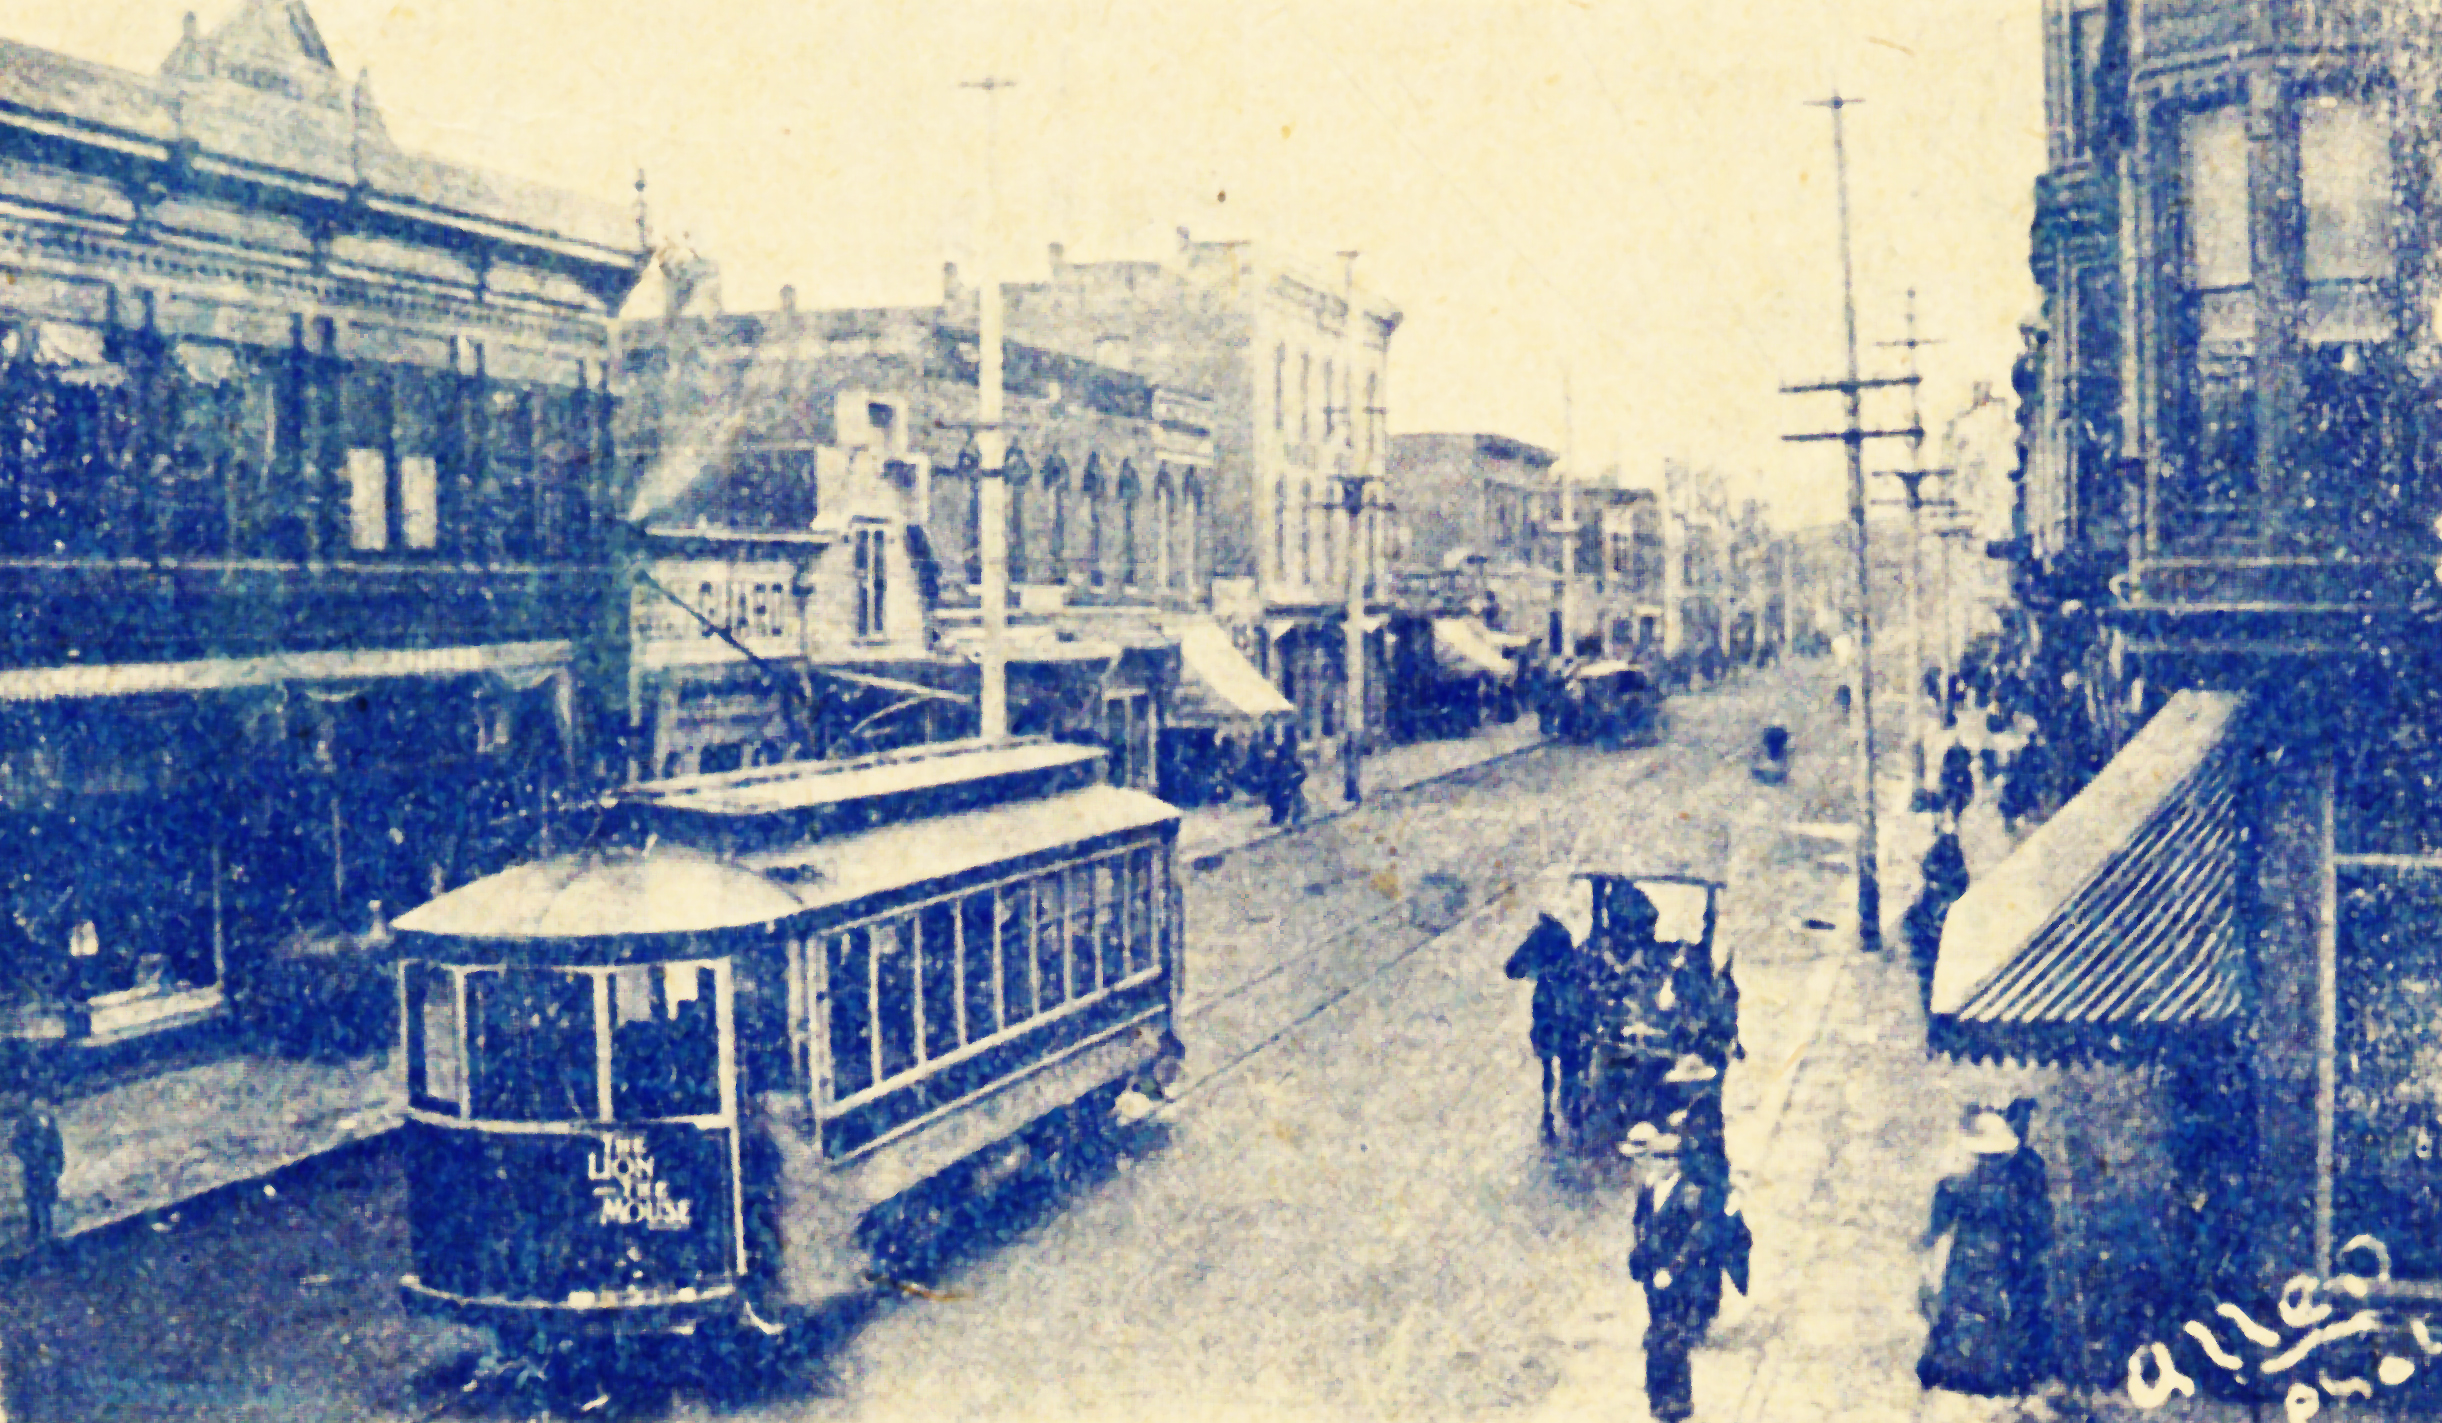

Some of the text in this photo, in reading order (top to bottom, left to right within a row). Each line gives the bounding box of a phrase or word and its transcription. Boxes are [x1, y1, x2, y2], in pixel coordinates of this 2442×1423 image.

[603, 1131, 647, 1154] THE
[588, 1151, 655, 1181] LION
[620, 1176, 669, 1200] THE
[601, 1198, 692, 1229] MOUSE
